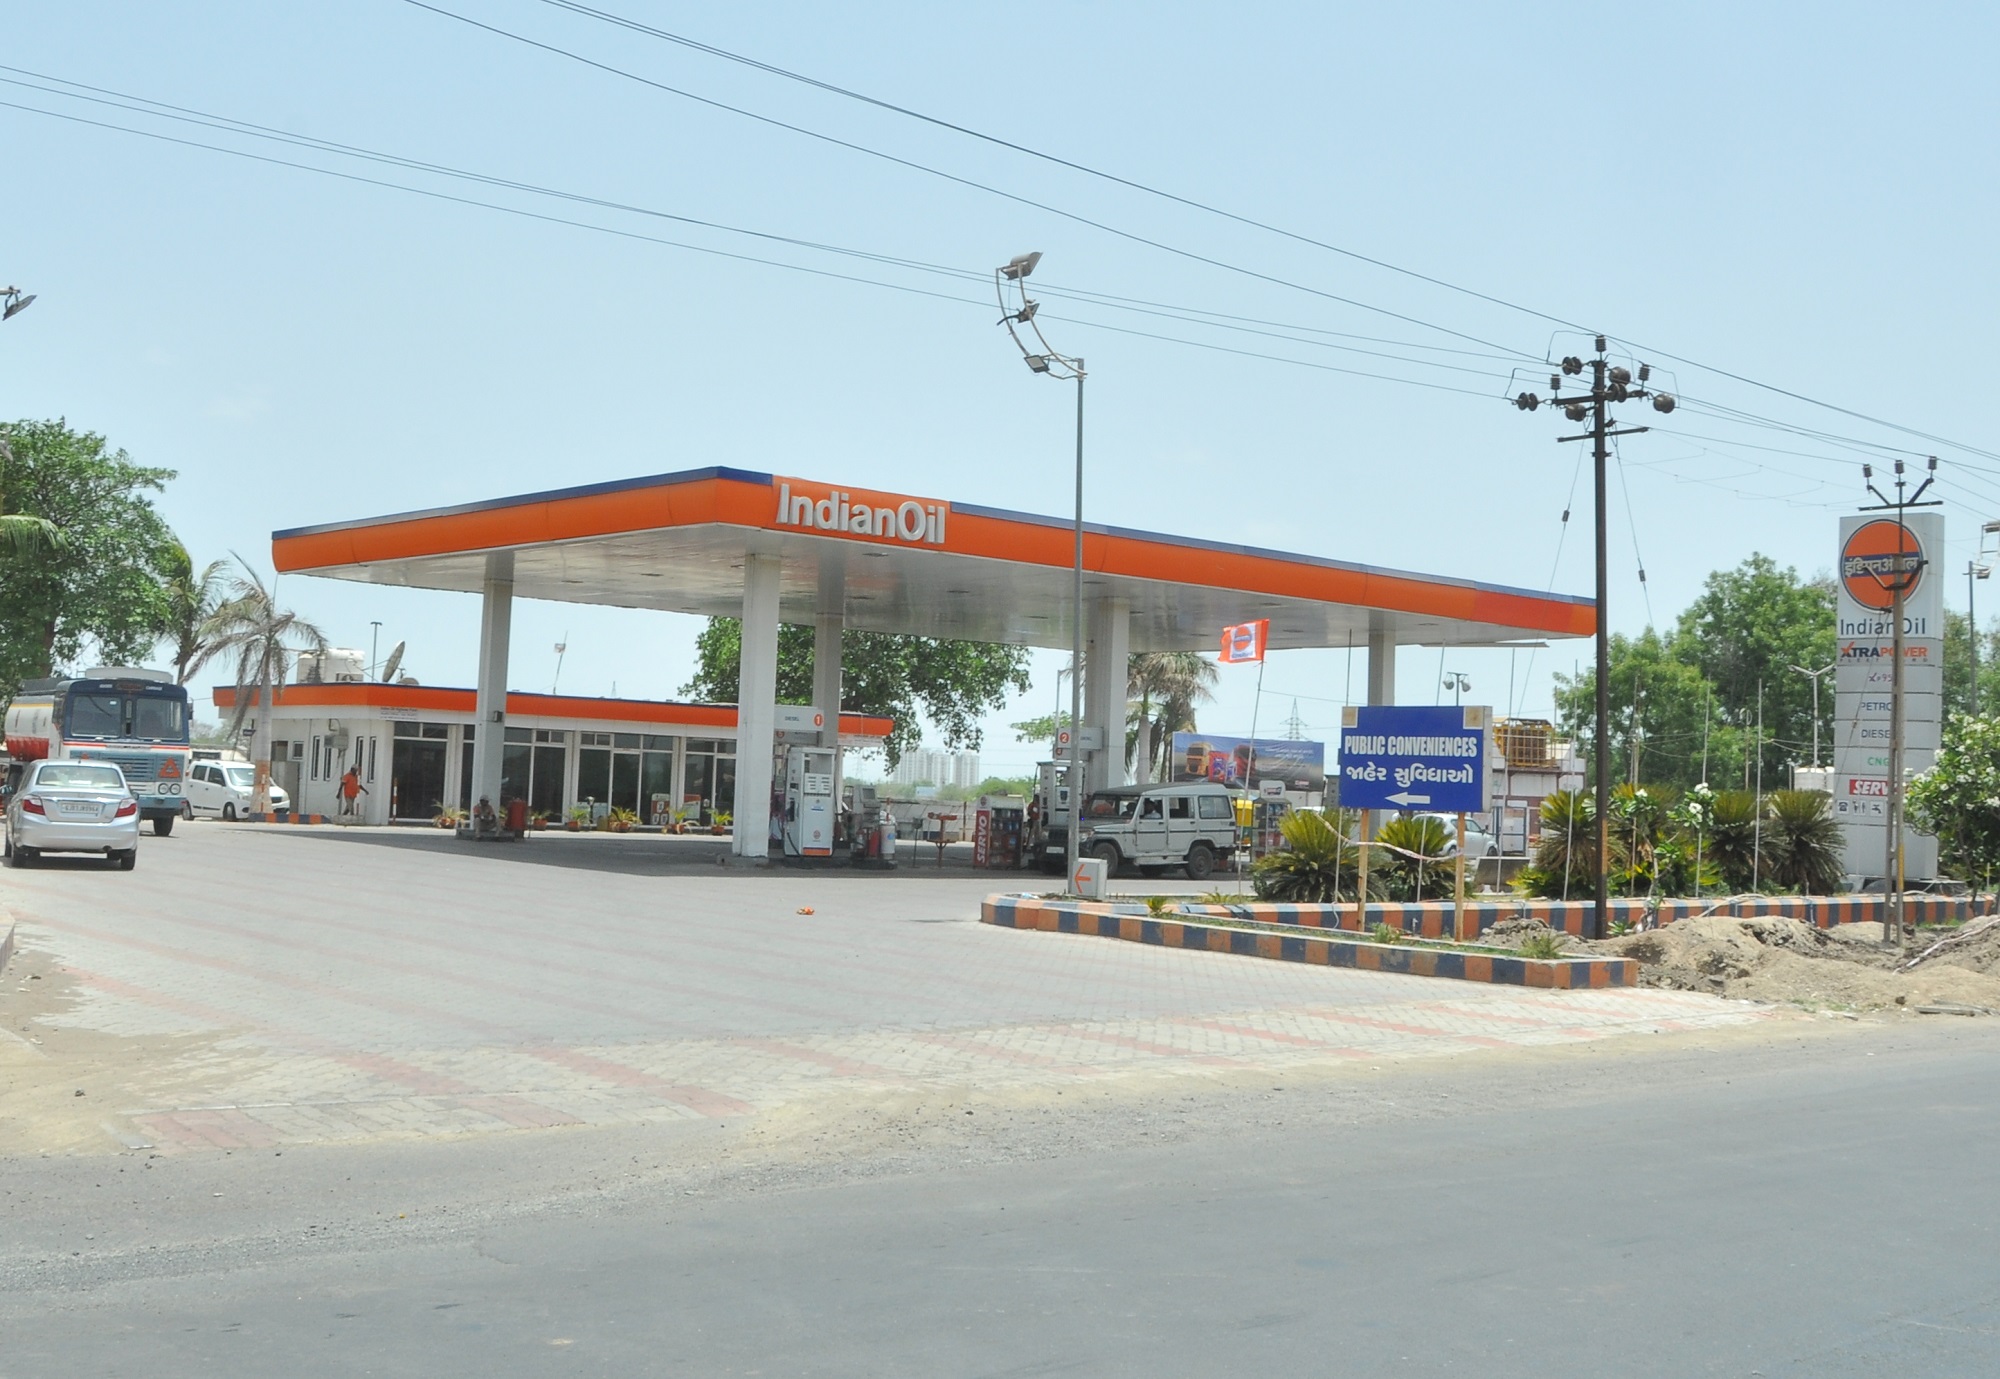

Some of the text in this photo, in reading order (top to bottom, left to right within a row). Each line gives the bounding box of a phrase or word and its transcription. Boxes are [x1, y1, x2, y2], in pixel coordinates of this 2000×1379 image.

[776, 483, 946, 544] IndianOil
[1860, 702, 1893, 711] PETRO
[1861, 729, 1891, 738] DIESE
[1344, 735, 1478, 758] PUBLIC CONVENIENCES
[1345, 761, 1474, 788] જાહેર સુવિધાઓ
[1853, 780, 1889, 795] SERV
[977, 815, 987, 864] SERVO
